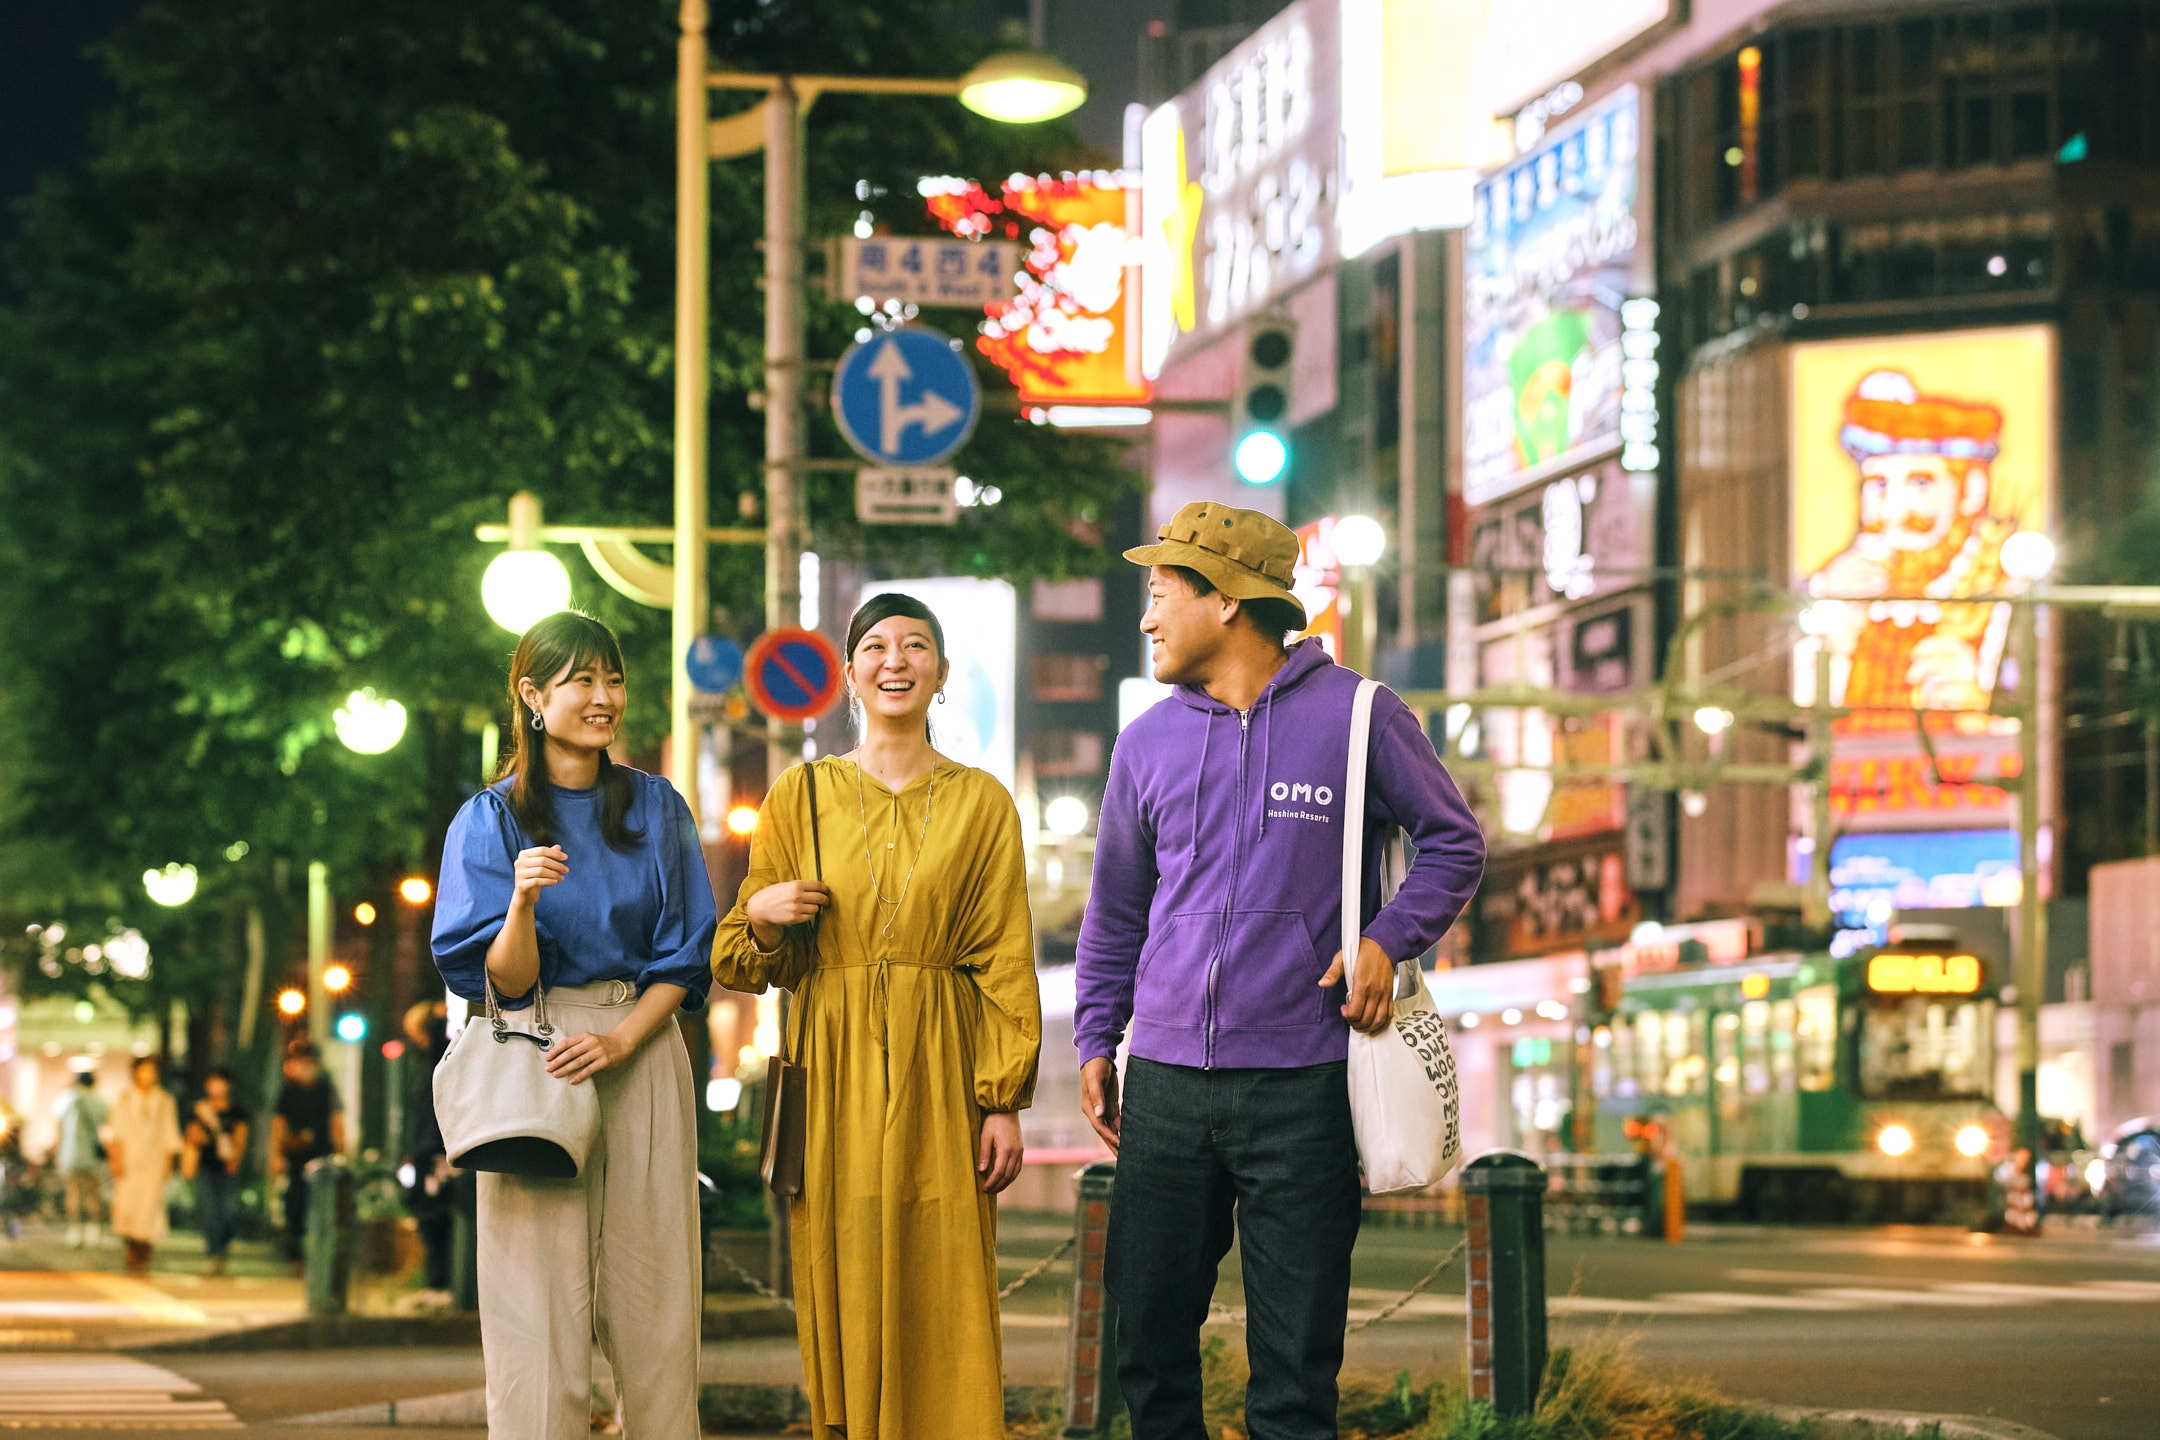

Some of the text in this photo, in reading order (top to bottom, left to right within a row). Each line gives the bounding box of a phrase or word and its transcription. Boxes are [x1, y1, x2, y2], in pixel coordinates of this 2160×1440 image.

[1270, 782, 1333, 806] OMO
[1268, 809, 1330, 824] Hoshino Resorts
